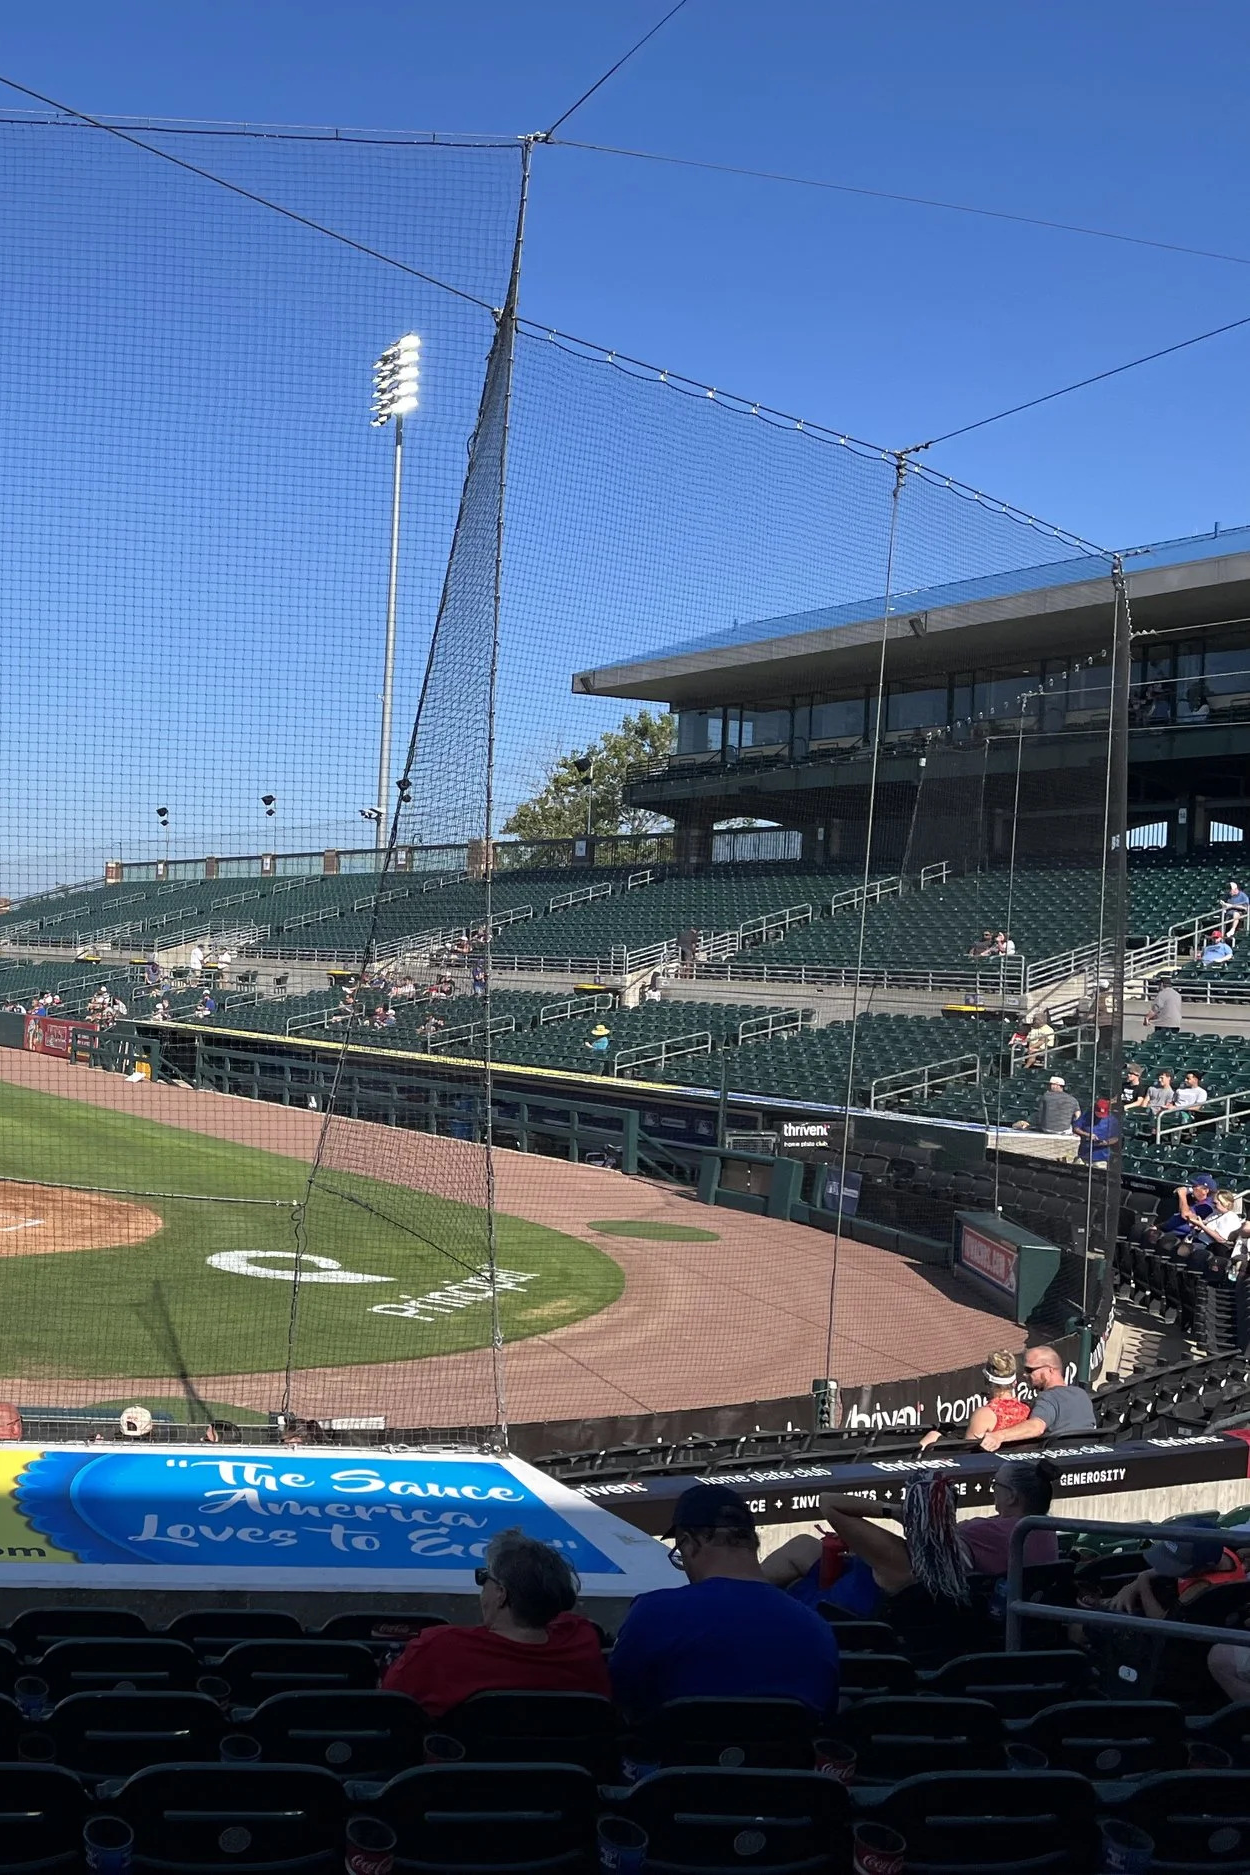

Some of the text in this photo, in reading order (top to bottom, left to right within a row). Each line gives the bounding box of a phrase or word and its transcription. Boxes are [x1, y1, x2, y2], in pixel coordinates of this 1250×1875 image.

[784, 1123, 830, 1137] thrivent
[367, 1264, 540, 1322] Principal
[695, 1465, 832, 1488] home plate club
[872, 1457, 961, 1473] thrivent
[330, 1469, 525, 1502] Sauce
[1060, 1468, 1126, 1487] GENEROSITY
[577, 1481, 648, 1500] rivent
[198, 1488, 489, 1530] America
[129, 1514, 380, 1552] Loves to
